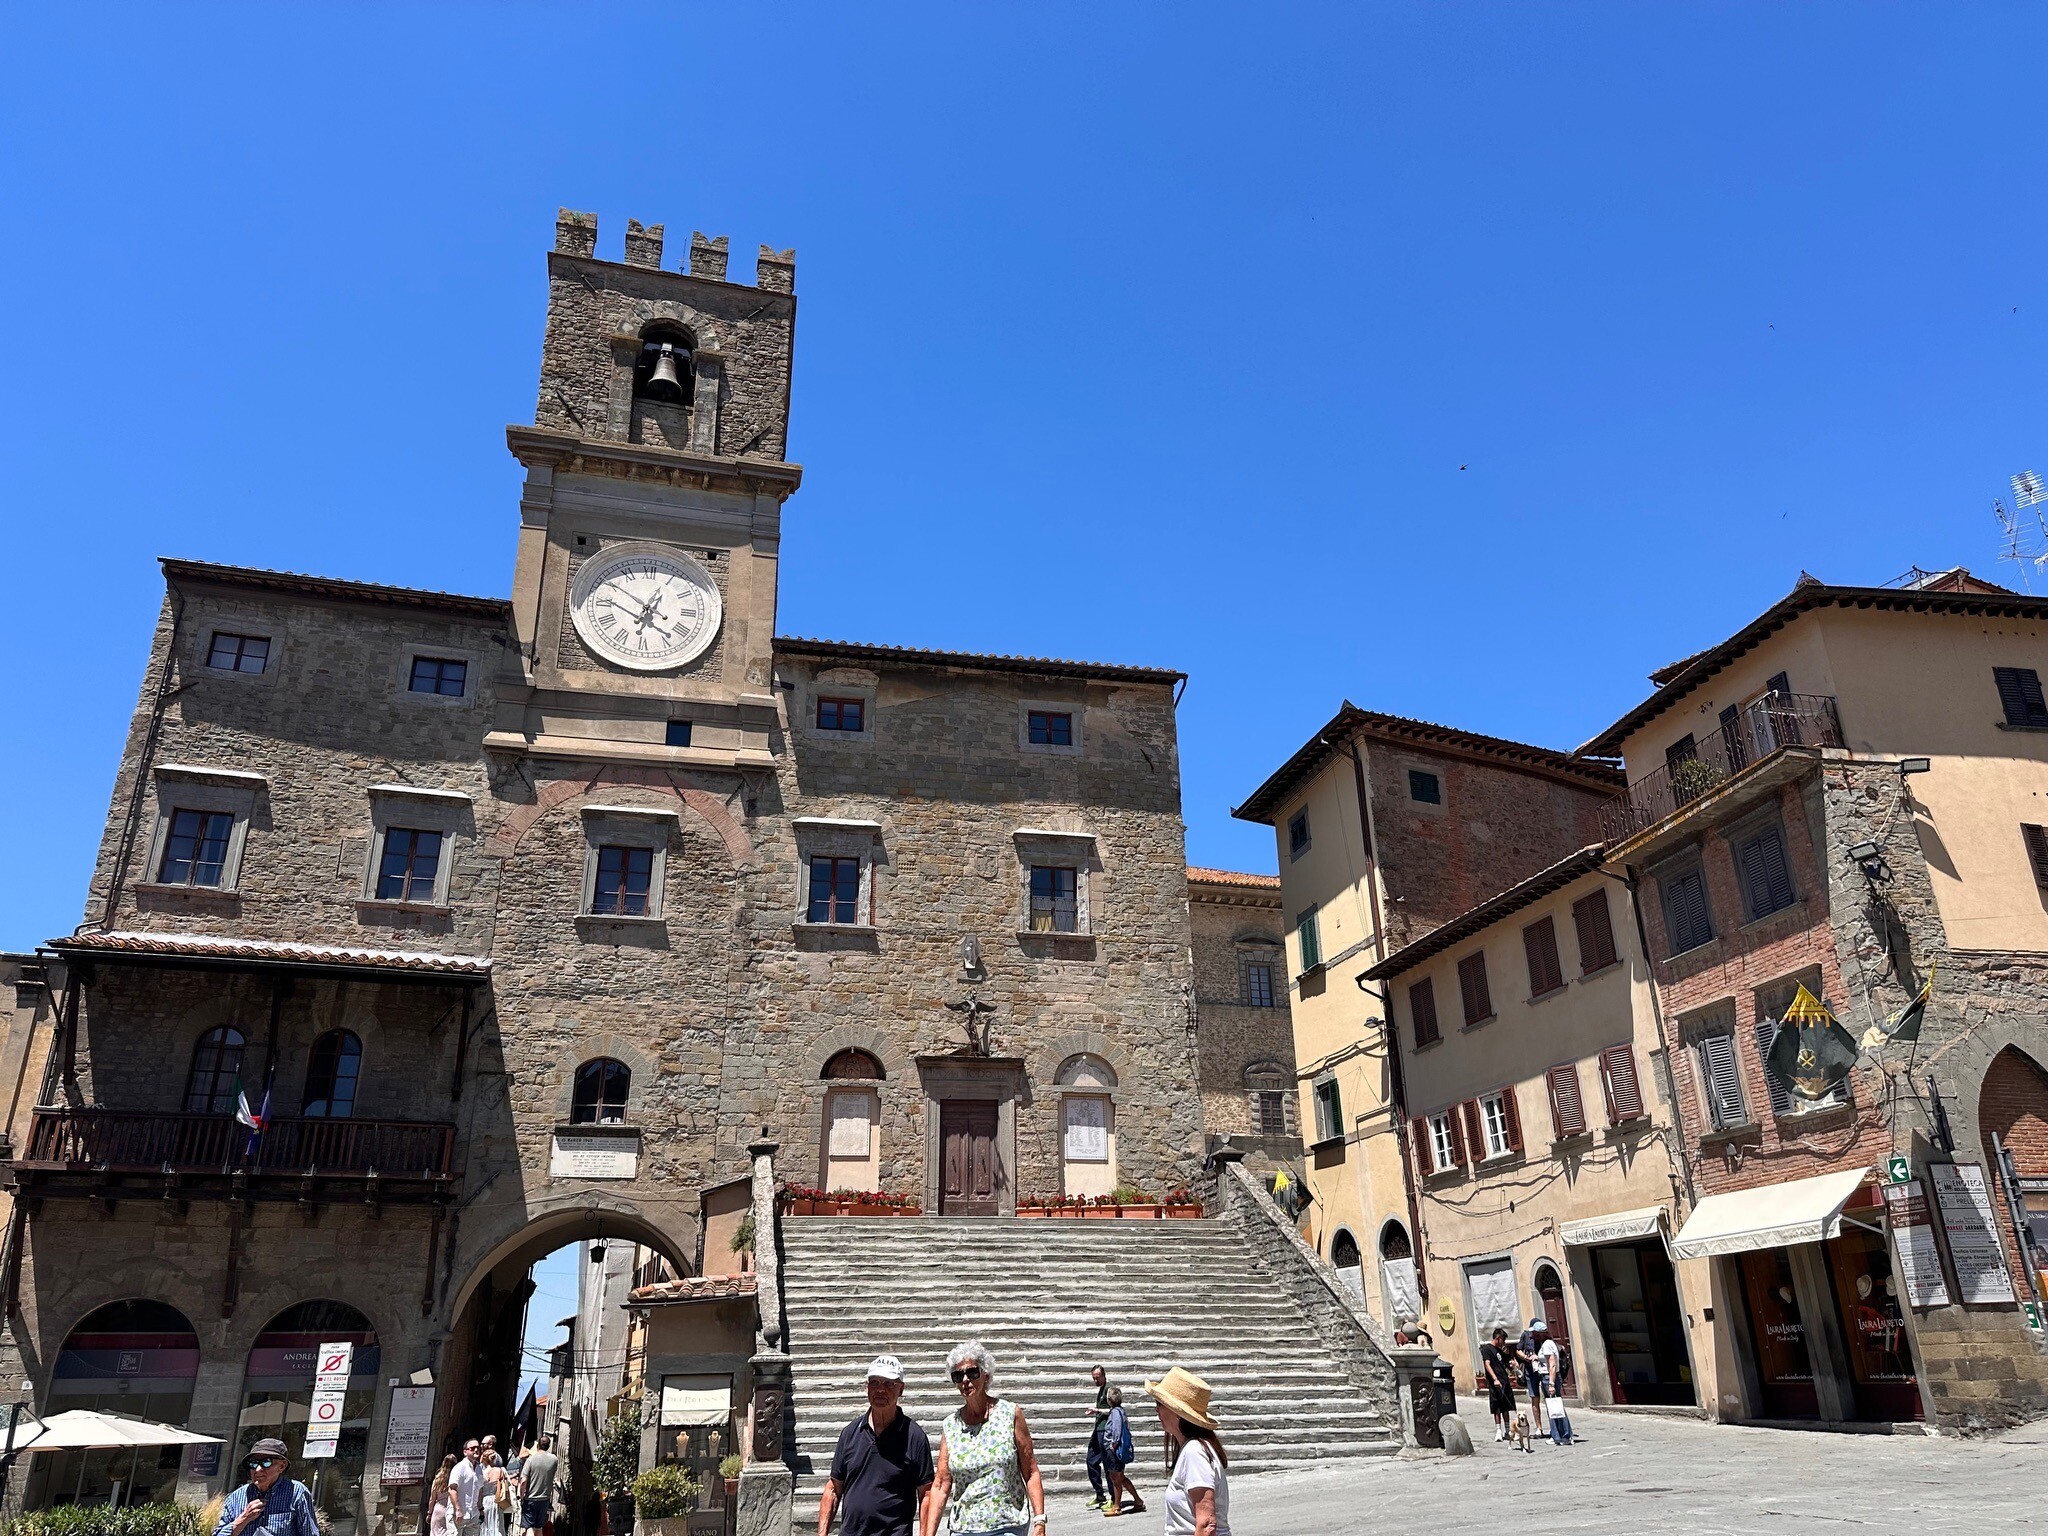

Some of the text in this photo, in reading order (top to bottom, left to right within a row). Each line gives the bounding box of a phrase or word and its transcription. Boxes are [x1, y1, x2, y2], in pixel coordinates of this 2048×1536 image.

[620, 567, 636, 583] XI
[642, 565, 657, 580] XII
[680, 608, 697, 618] III
[661, 634, 671, 649] V
[1952, 1179, 1984, 1187] ENOTECA
[1956, 1197, 1988, 1205] PRELUDIO
[282, 1353, 317, 1361] ANDREA
[391, 1448, 427, 1456] PRELUDIO
